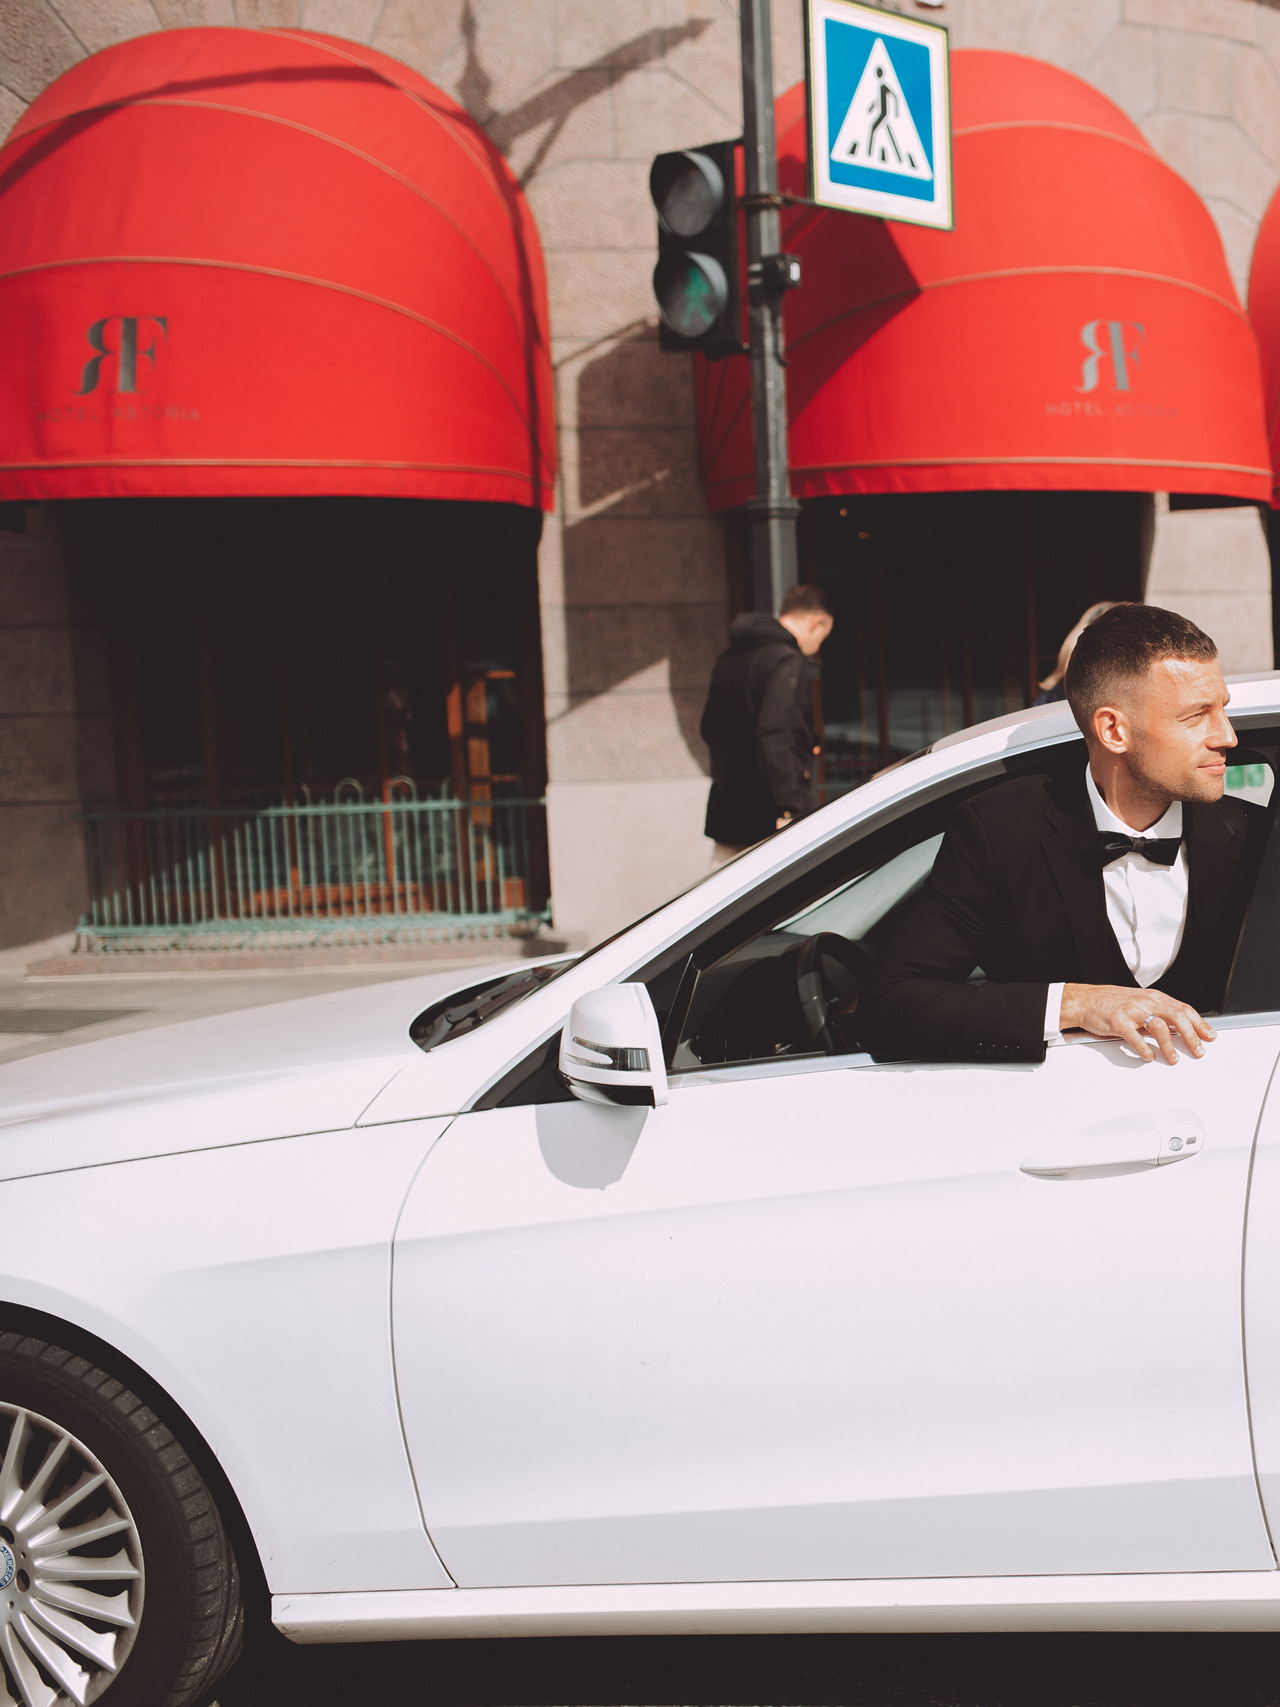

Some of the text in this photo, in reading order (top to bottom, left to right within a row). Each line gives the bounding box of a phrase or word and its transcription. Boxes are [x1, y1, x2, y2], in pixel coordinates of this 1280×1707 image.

[36, 406, 99, 423] HOTEL
[112, 404, 201, 422] ASTORIA
[1045, 401, 1104, 417] HOTEL
